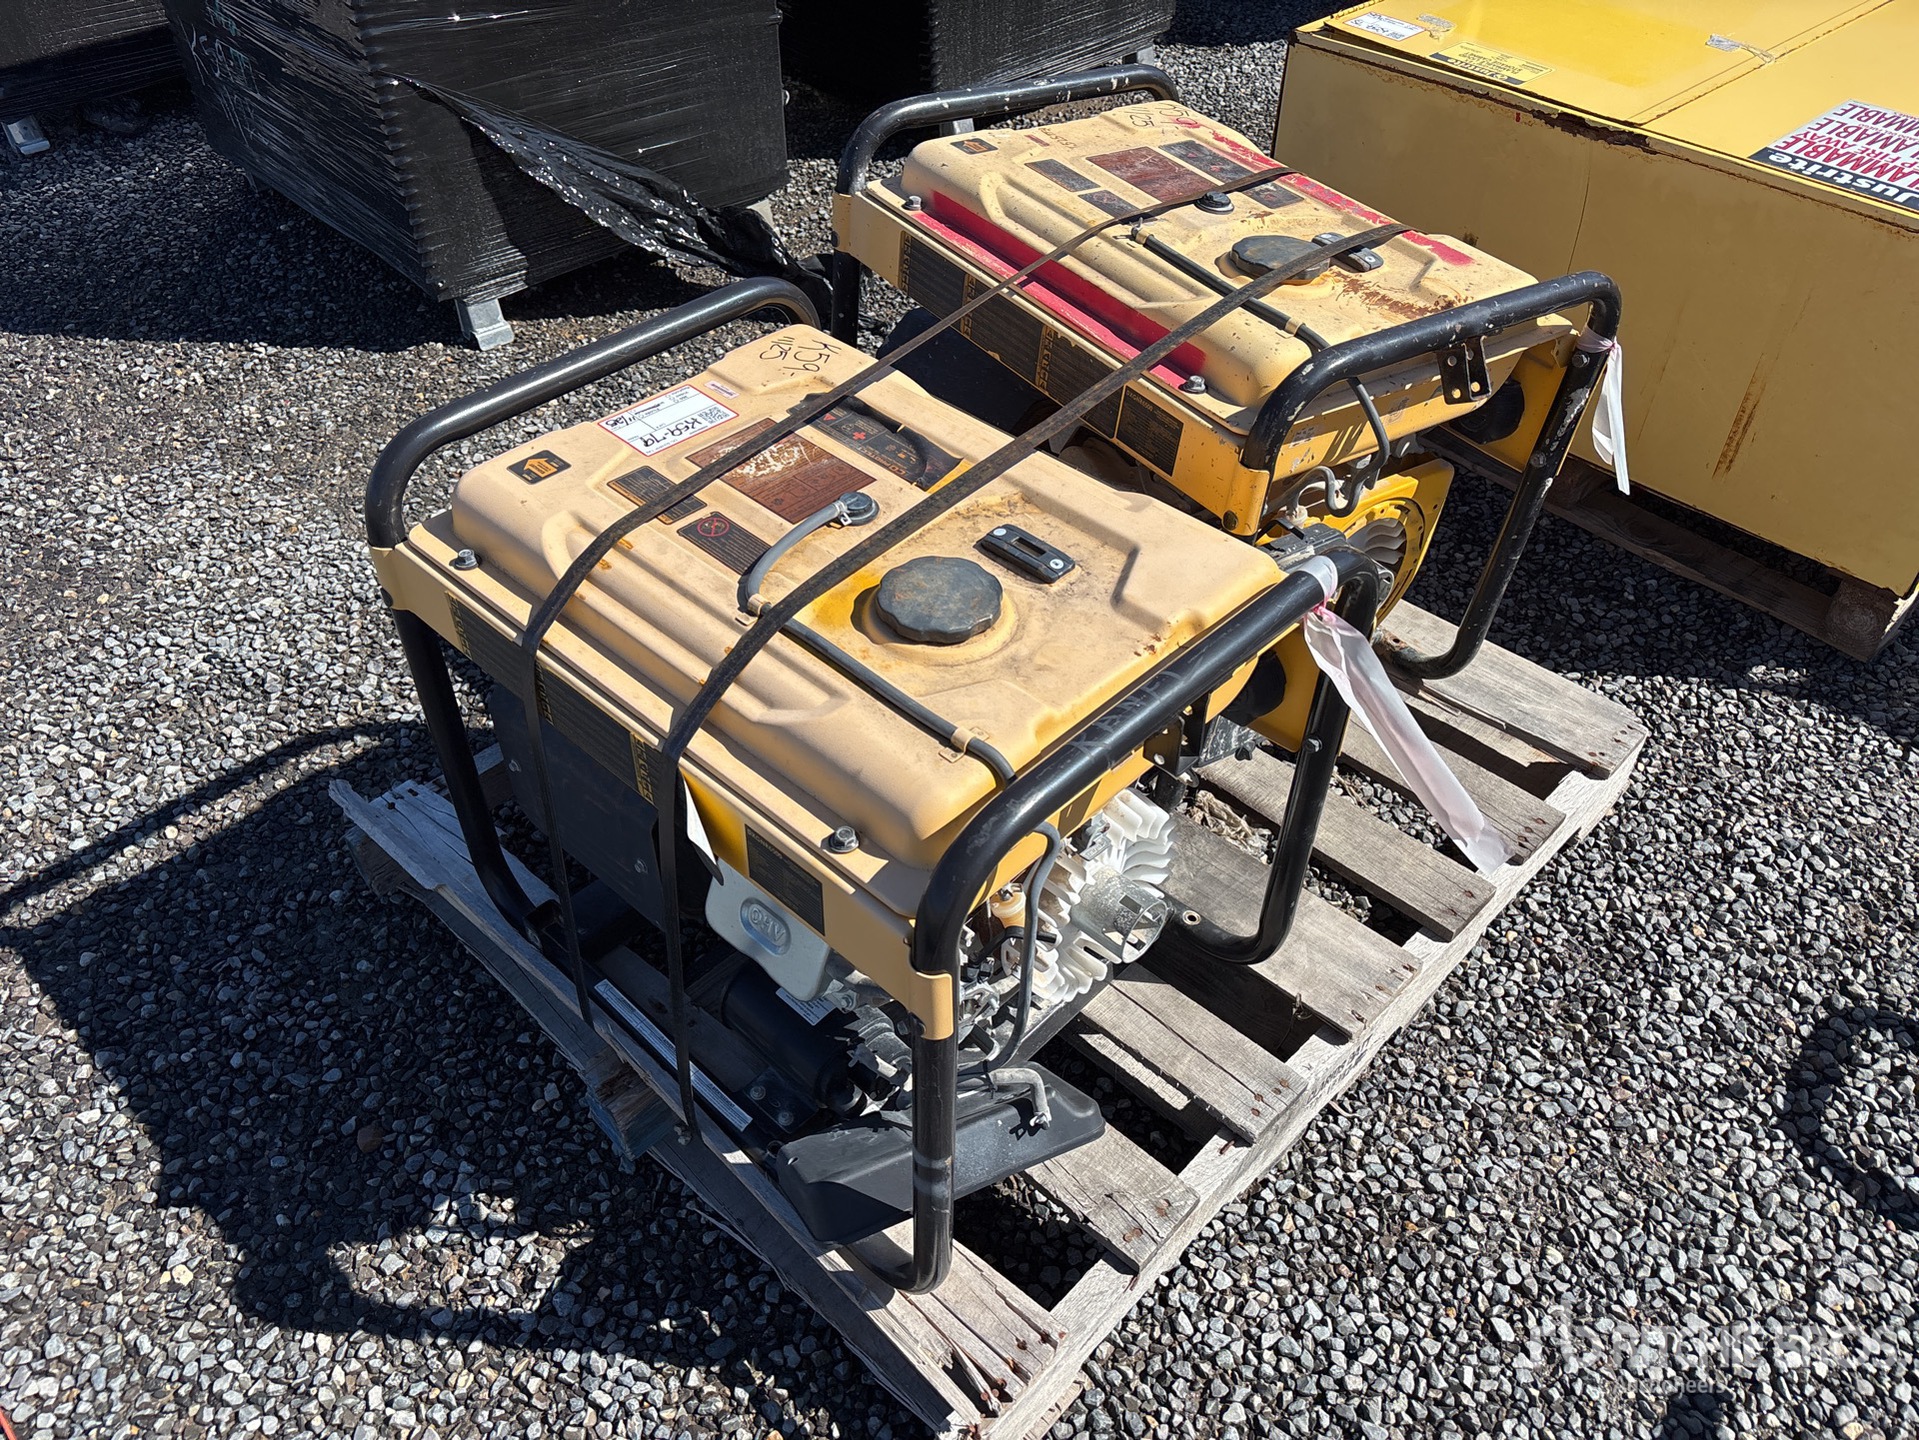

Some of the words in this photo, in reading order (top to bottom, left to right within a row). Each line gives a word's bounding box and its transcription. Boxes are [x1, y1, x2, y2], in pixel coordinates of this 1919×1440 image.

[1796, 132, 1857, 150] AWAY
[1857, 146, 1901, 164] FIRE
[1768, 153, 1919, 204] Justrite
[640, 417, 702, 447] K59-79
